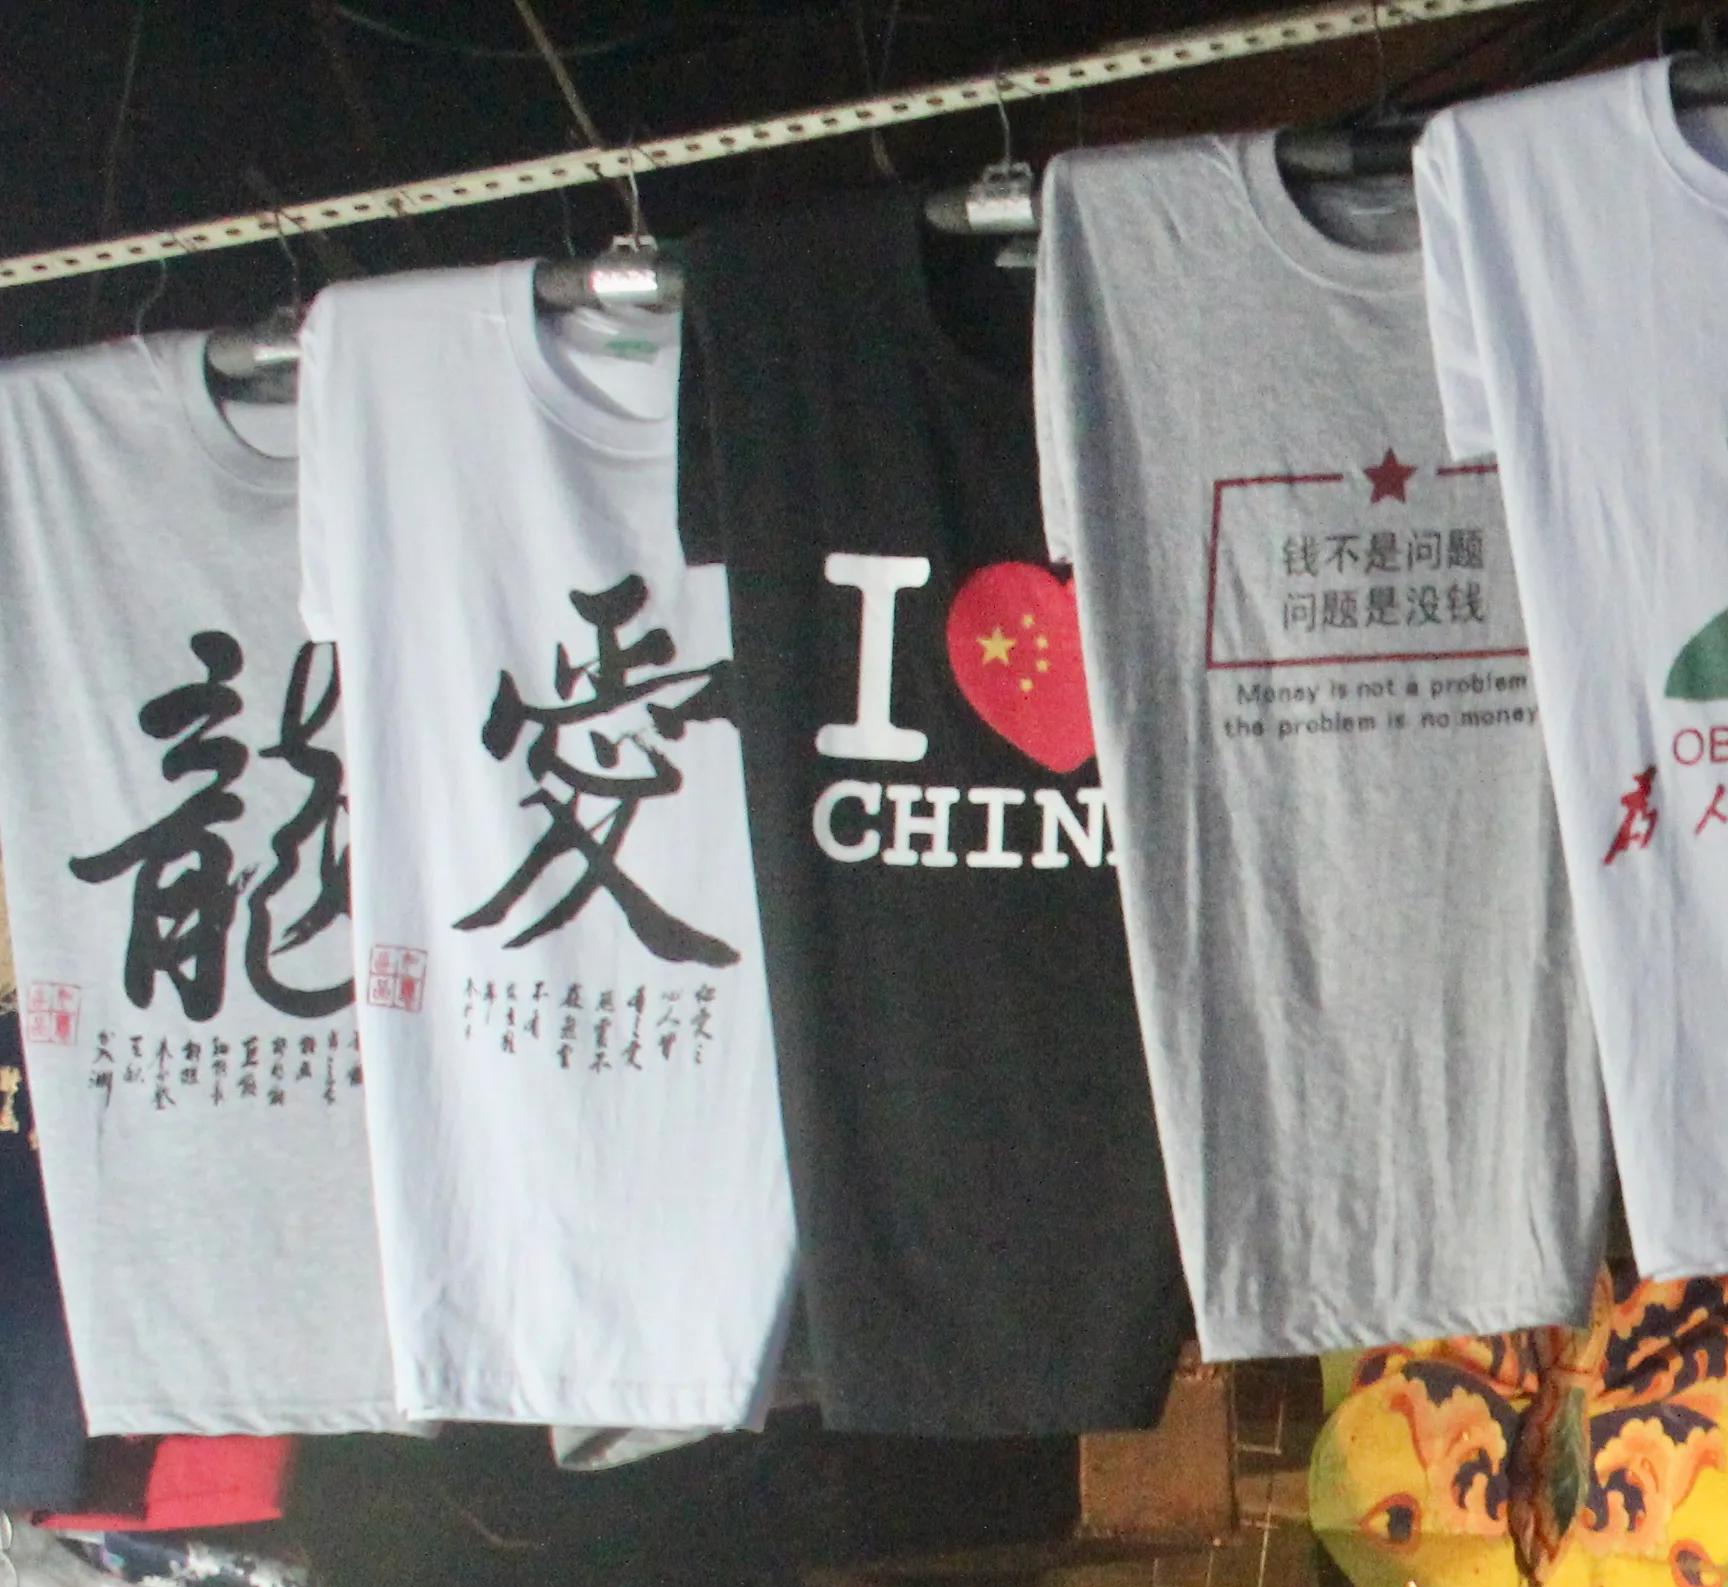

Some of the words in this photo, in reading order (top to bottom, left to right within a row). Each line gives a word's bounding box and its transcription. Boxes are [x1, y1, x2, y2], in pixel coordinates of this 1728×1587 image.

[1283, 528, 1484, 576] 钱不是问题
[1282, 582, 1486, 632] 问题是没钱
[815, 552, 931, 762] I
[1237, 683, 1319, 705] Money
[1331, 679, 1347, 697] is
[1357, 679, 1396, 698] not
[1406, 681, 1418, 696] a
[1431, 672, 1528, 698] problem
[1224, 719, 1264, 738] the
[1277, 712, 1376, 740] problem
[1387, 711, 1405, 728] is
[1421, 710, 1450, 728] no
[1459, 705, 1540, 727] money
[813, 778, 1121, 870] CHIN
